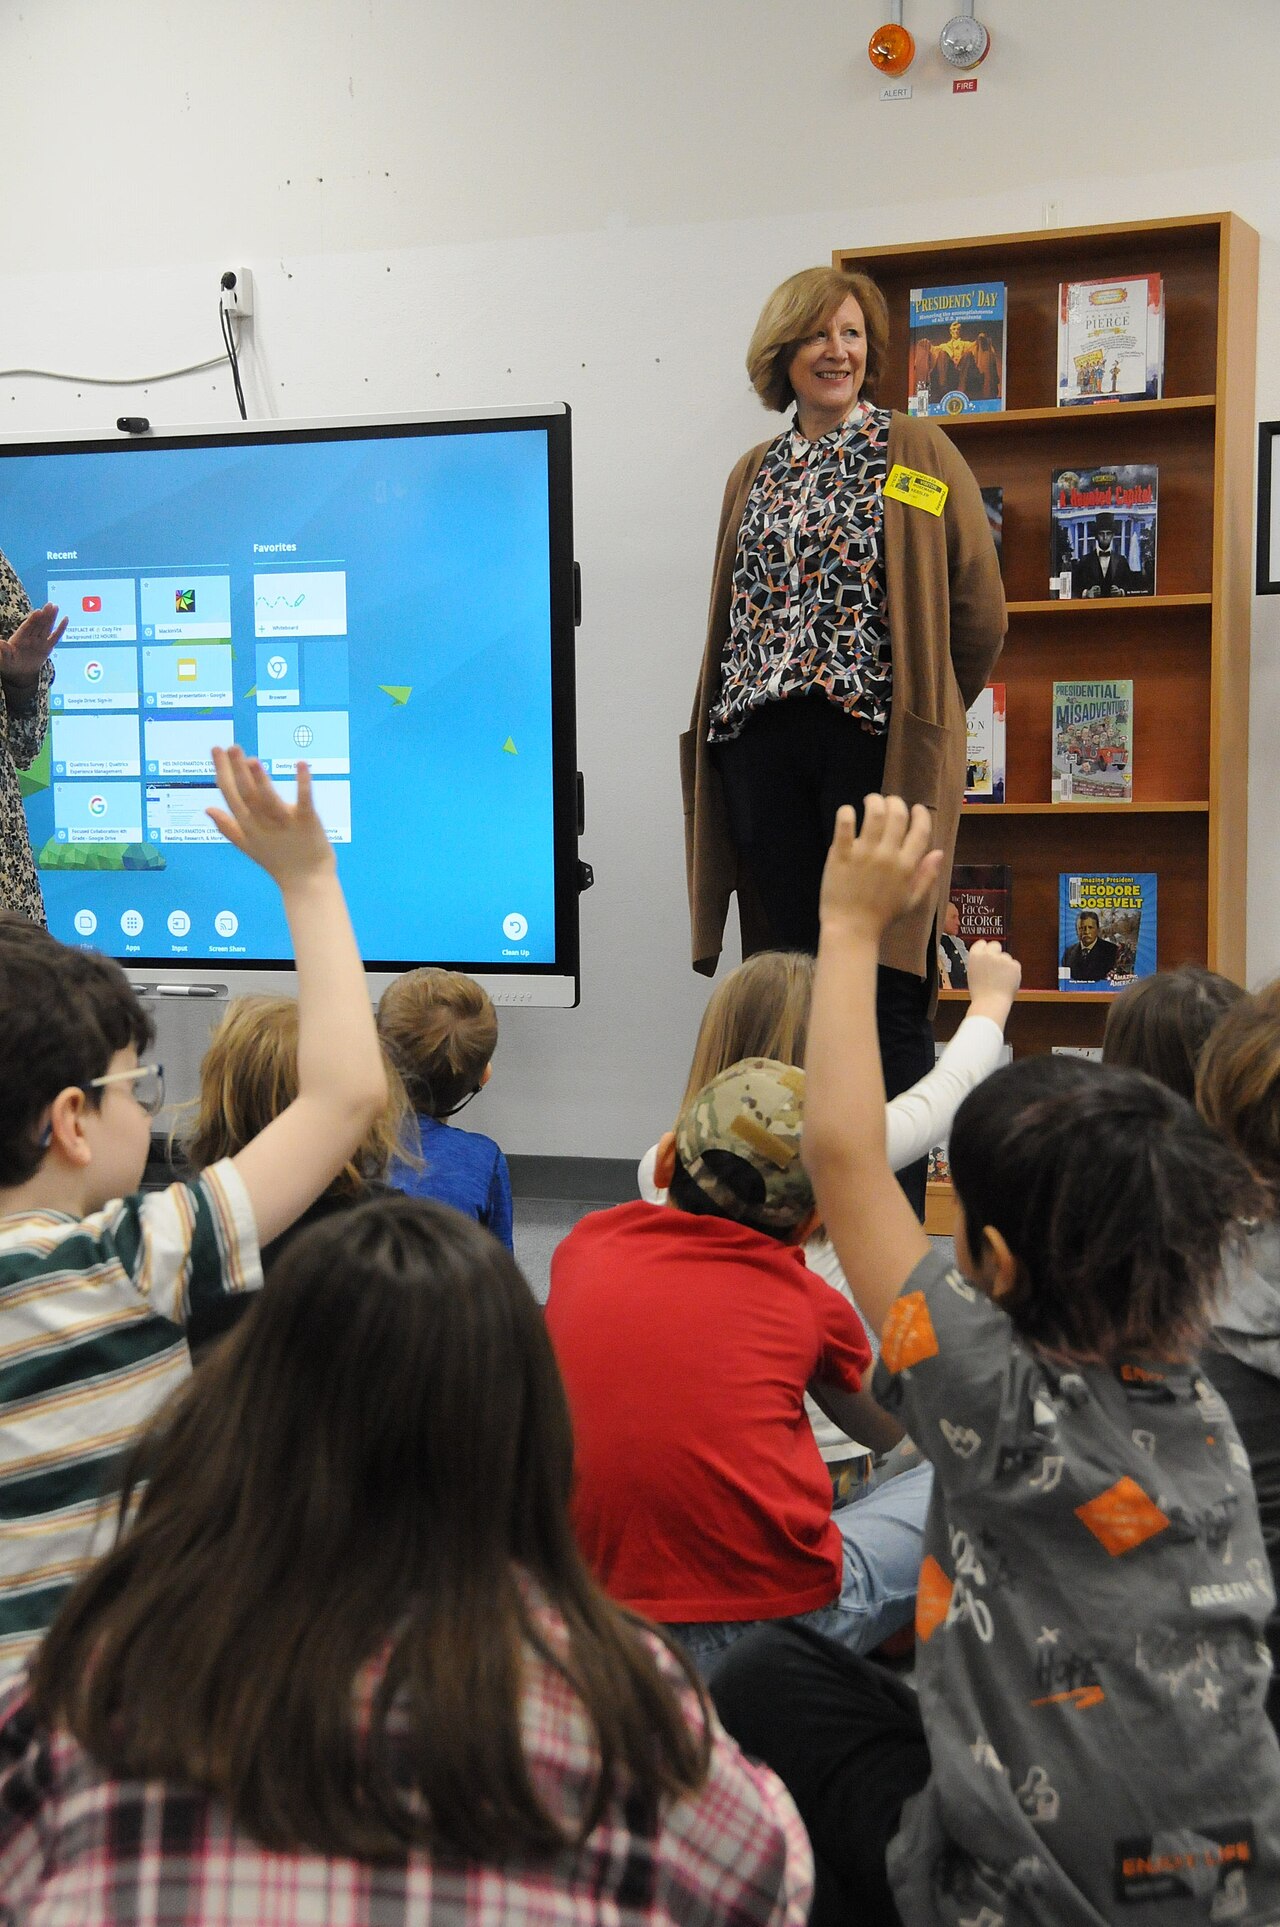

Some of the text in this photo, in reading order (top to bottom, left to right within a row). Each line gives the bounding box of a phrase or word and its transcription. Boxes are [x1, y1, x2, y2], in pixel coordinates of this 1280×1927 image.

[957, 82, 974, 90] FIRE
[884, 88, 907, 97] ALERT
[915, 290, 998, 313] PRESIDENTS' DAY
[1086, 316, 1130, 330] PIERCE
[920, 480, 938, 490] VISITOR
[1070, 486, 1112, 507] Haunted
[253, 543, 297, 553] Favorites
[47, 551, 77, 560] Recent
[1056, 685, 1121, 699] PRESIDENTIAL
[1081, 885, 1141, 896] HEODORE
[961, 893, 984, 905] Many
[962, 903, 989, 915] Faces
[961, 915, 1003, 926] GEORGE
[960, 926, 1003, 934] WASHINGTON
[125, 944, 141, 952] Apps
[171, 945, 188, 953] Input
[229, 945, 246, 953] Share
[520, 949, 530, 957] Up
